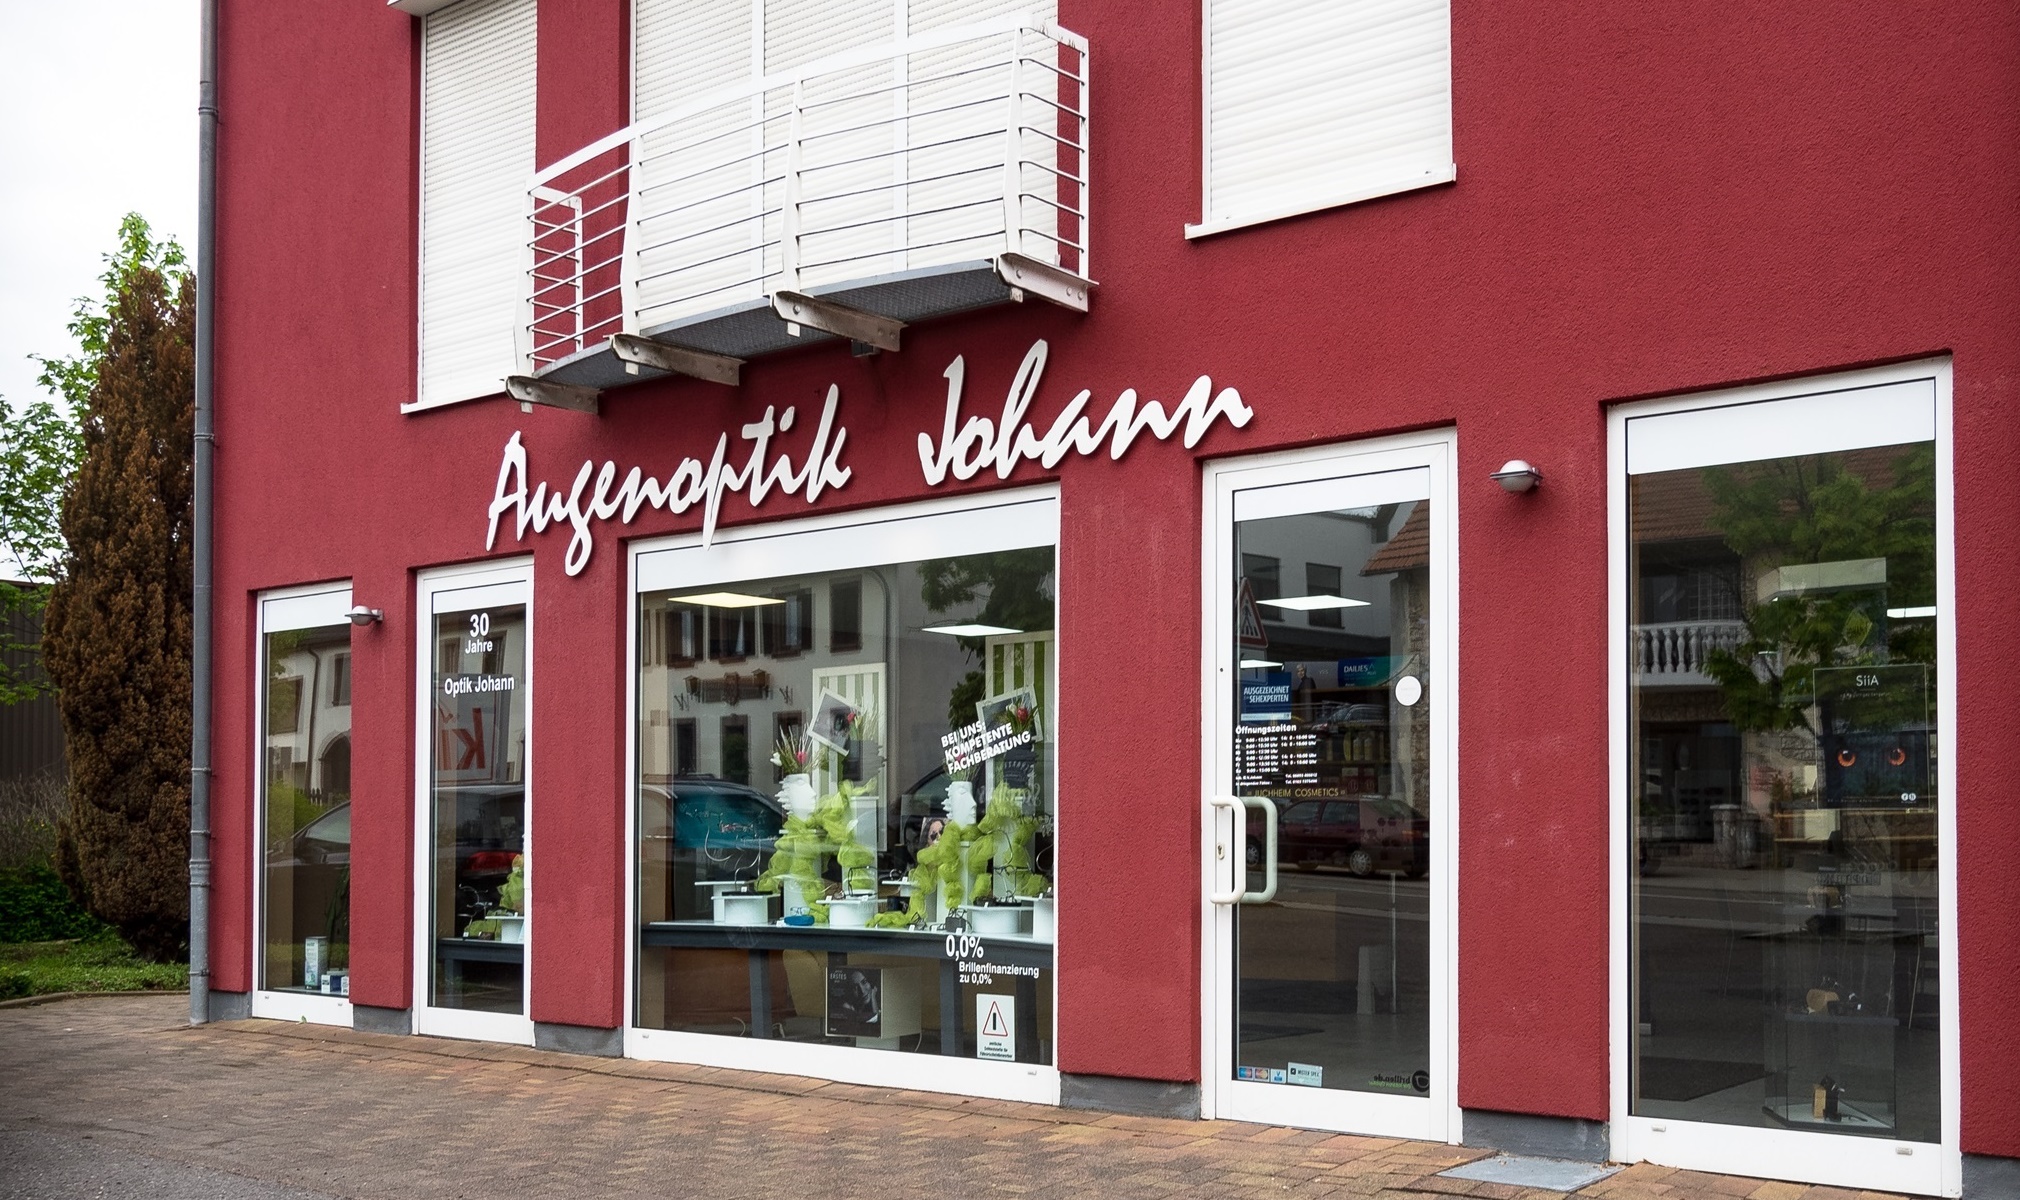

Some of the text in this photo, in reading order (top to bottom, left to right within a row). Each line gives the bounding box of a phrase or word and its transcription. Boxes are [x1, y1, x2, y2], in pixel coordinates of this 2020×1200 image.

[486, 338, 1253, 577] Augenoptik Johann
[470, 613, 490, 637] 30
[465, 640, 493, 654] Jahre
[445, 675, 515, 698] Optik Johann
[1856, 675, 1879, 686] SiiA
[1244, 686, 1290, 695] AUSGEZEICHNET
[1250, 694, 1289, 703] SEHEXPERTEN
[941, 720, 986, 748] BEI UNS:
[1235, 724, 1297, 735] Öffnungszeiten
[945, 722, 1013, 763] KOMPETENTE
[948, 731, 1031, 775] FACHBERATUNG
[1295, 788, 1339, 797] COSMETICS
[946, 934, 984, 962] 0,0%
[959, 961, 1040, 979] Brillenfinanzierung
[960, 973, 992, 986] zu 0,0%
